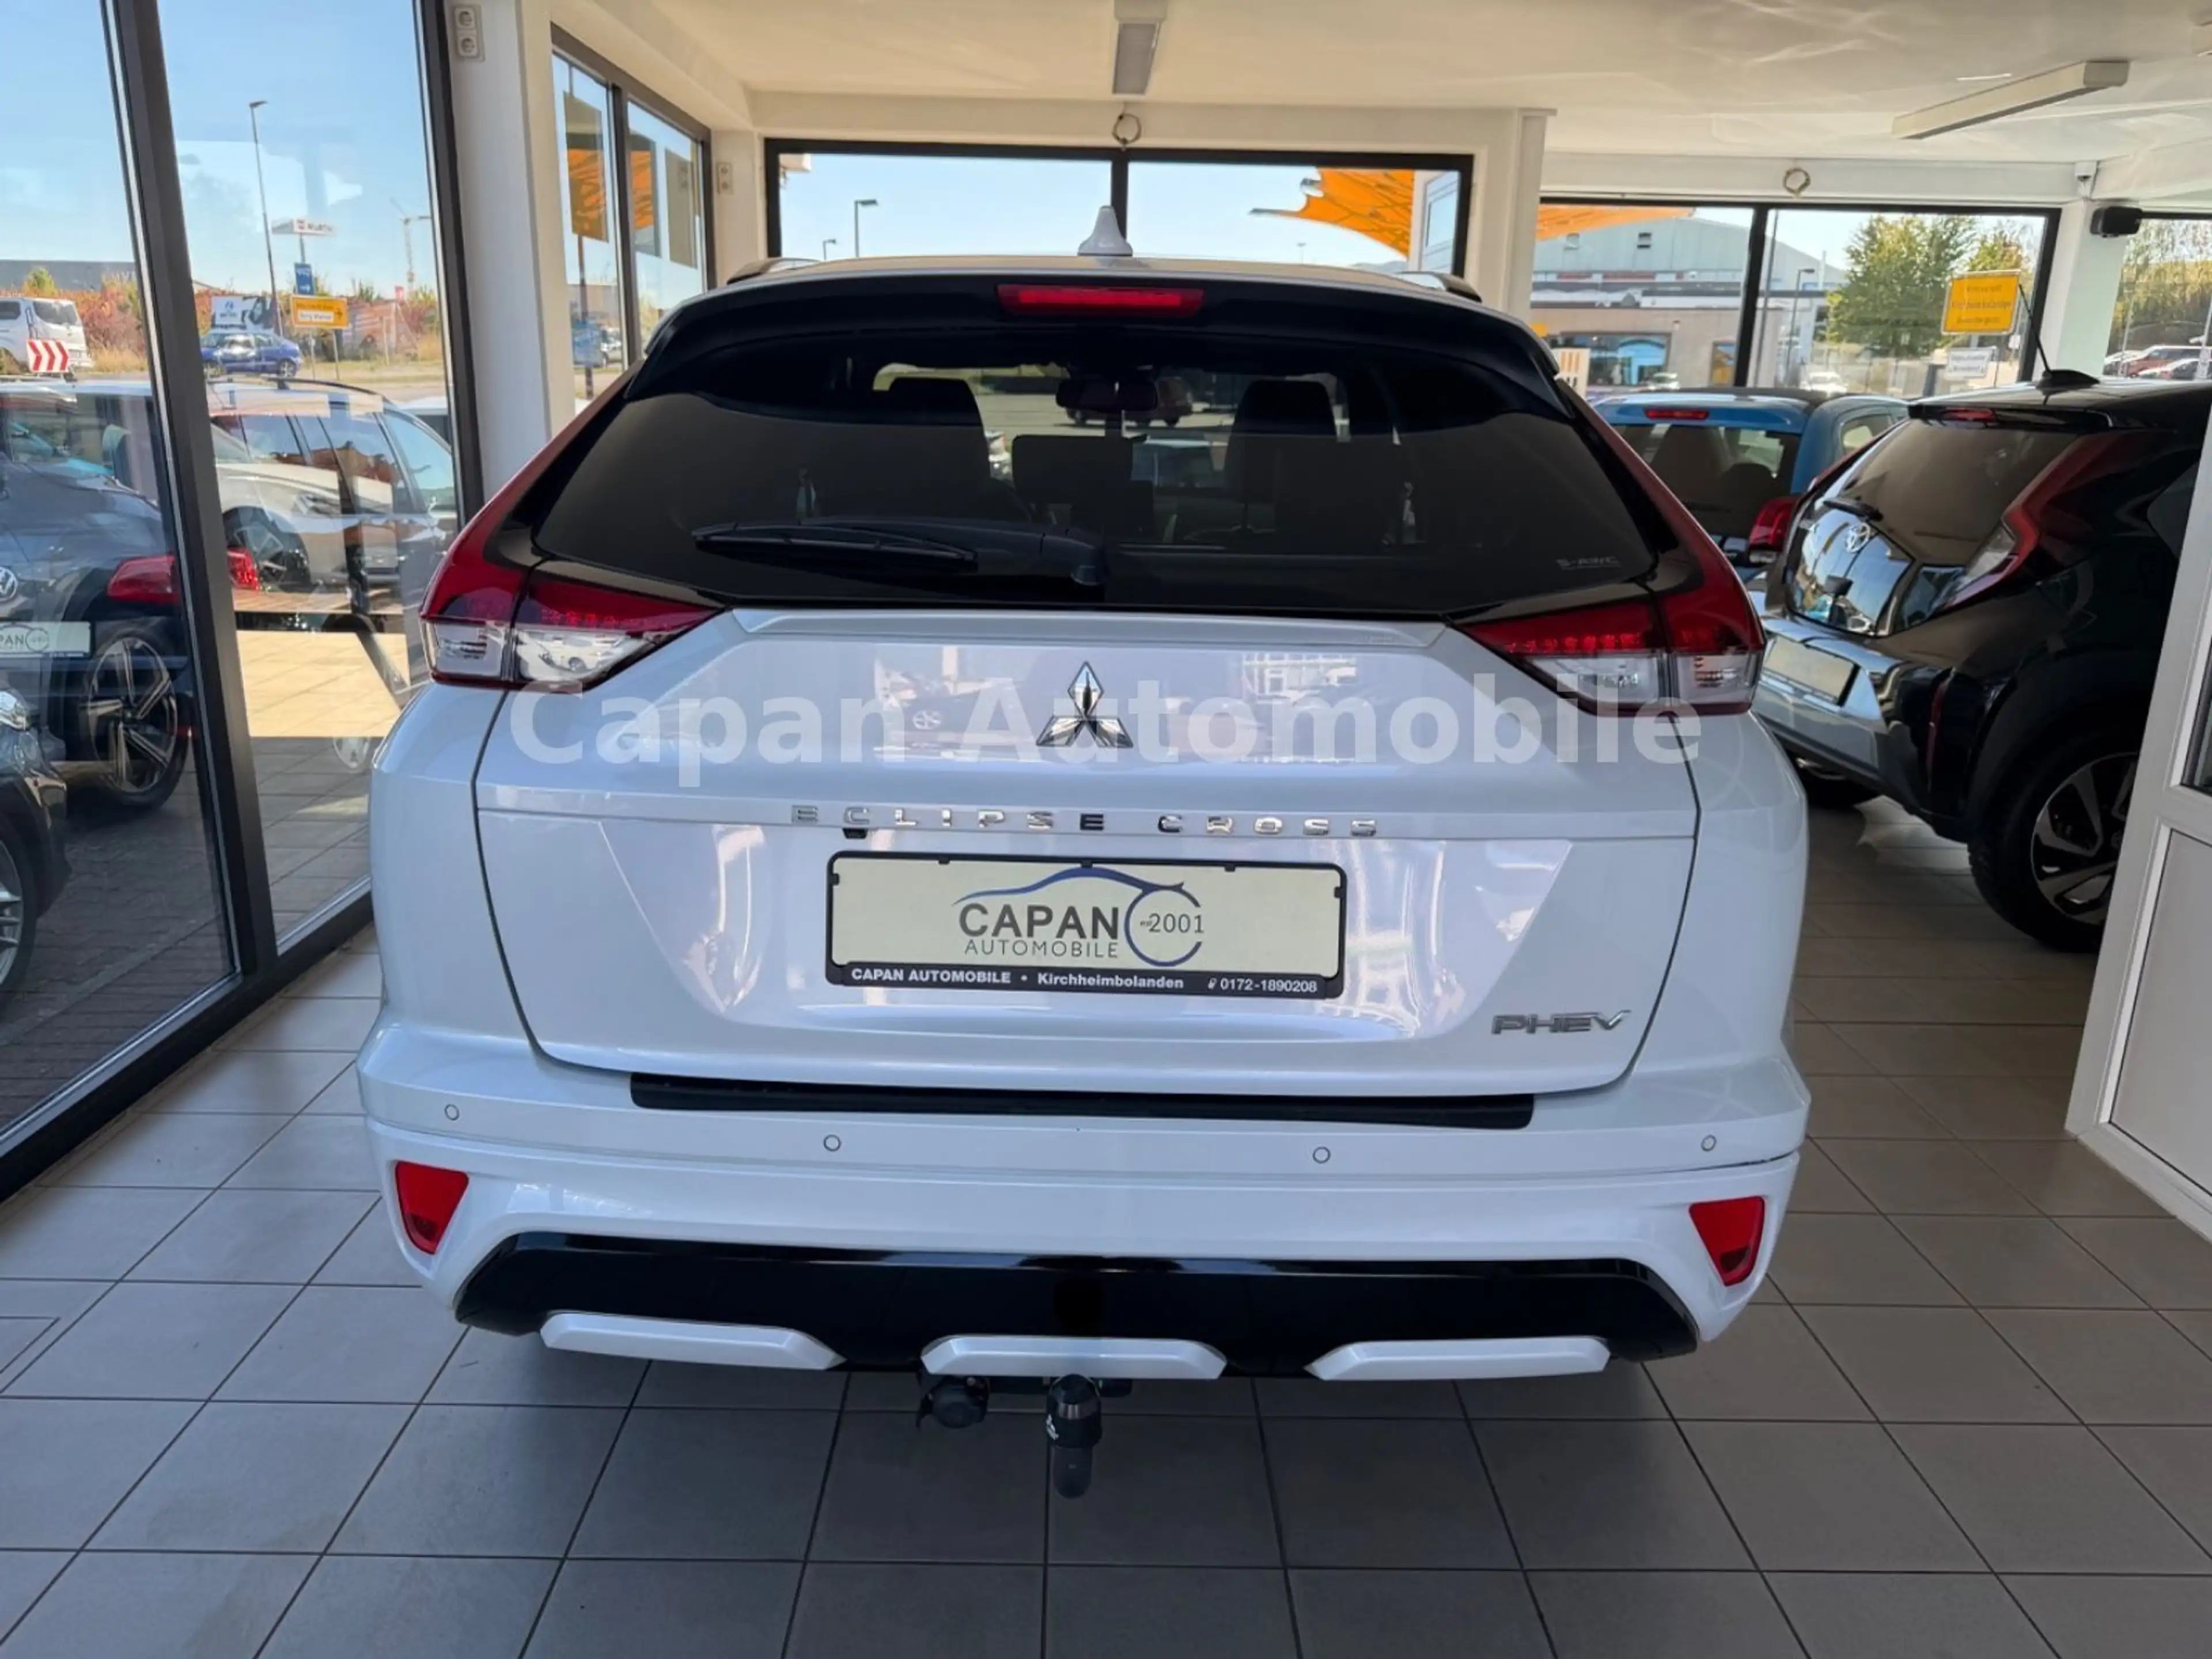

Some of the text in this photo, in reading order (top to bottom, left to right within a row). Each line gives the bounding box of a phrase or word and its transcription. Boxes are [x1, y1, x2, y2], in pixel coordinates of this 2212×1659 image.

[791, 805, 1377, 836] ECLIPSE CROSS
[959, 903, 1119, 940] CAPAN
[1149, 912, 1204, 934] 2001
[965, 939, 1118, 959] AUTOMOBILE
[851, 968, 1317, 993] CAPAN AUTOMOBILE Kirchheimbolanden 0172-1890208
[1492, 1009, 1632, 1035] PHEV
